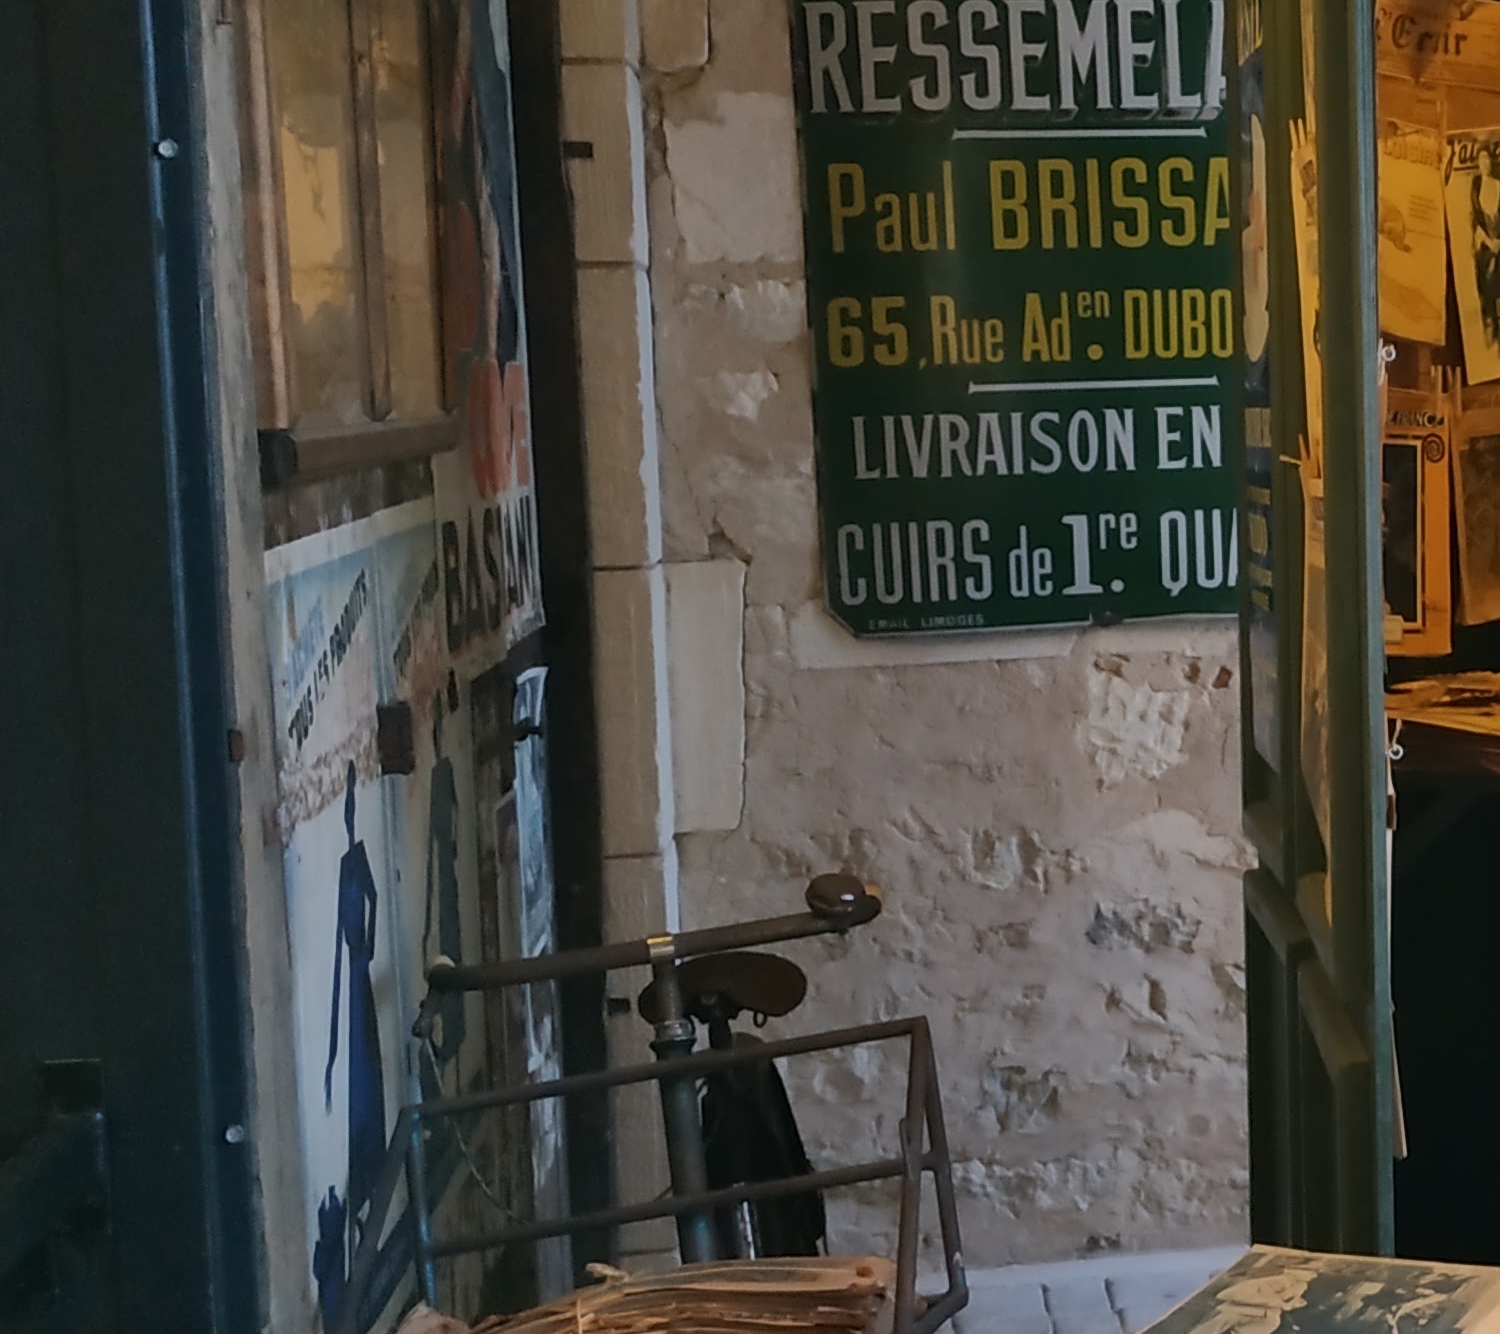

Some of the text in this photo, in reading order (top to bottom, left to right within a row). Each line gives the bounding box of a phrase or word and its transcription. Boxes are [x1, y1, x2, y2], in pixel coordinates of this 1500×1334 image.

[828, 160, 955, 253] Paul
[1123, 288, 1233, 360] DUBO
[852, 408, 1136, 479] LIVRAISON
[1154, 404, 1222, 470] EN
[837, 519, 993, 606] CUIRS
[1009, 524, 1053, 598] de
[921, 612, 985, 627] LIMOGES
